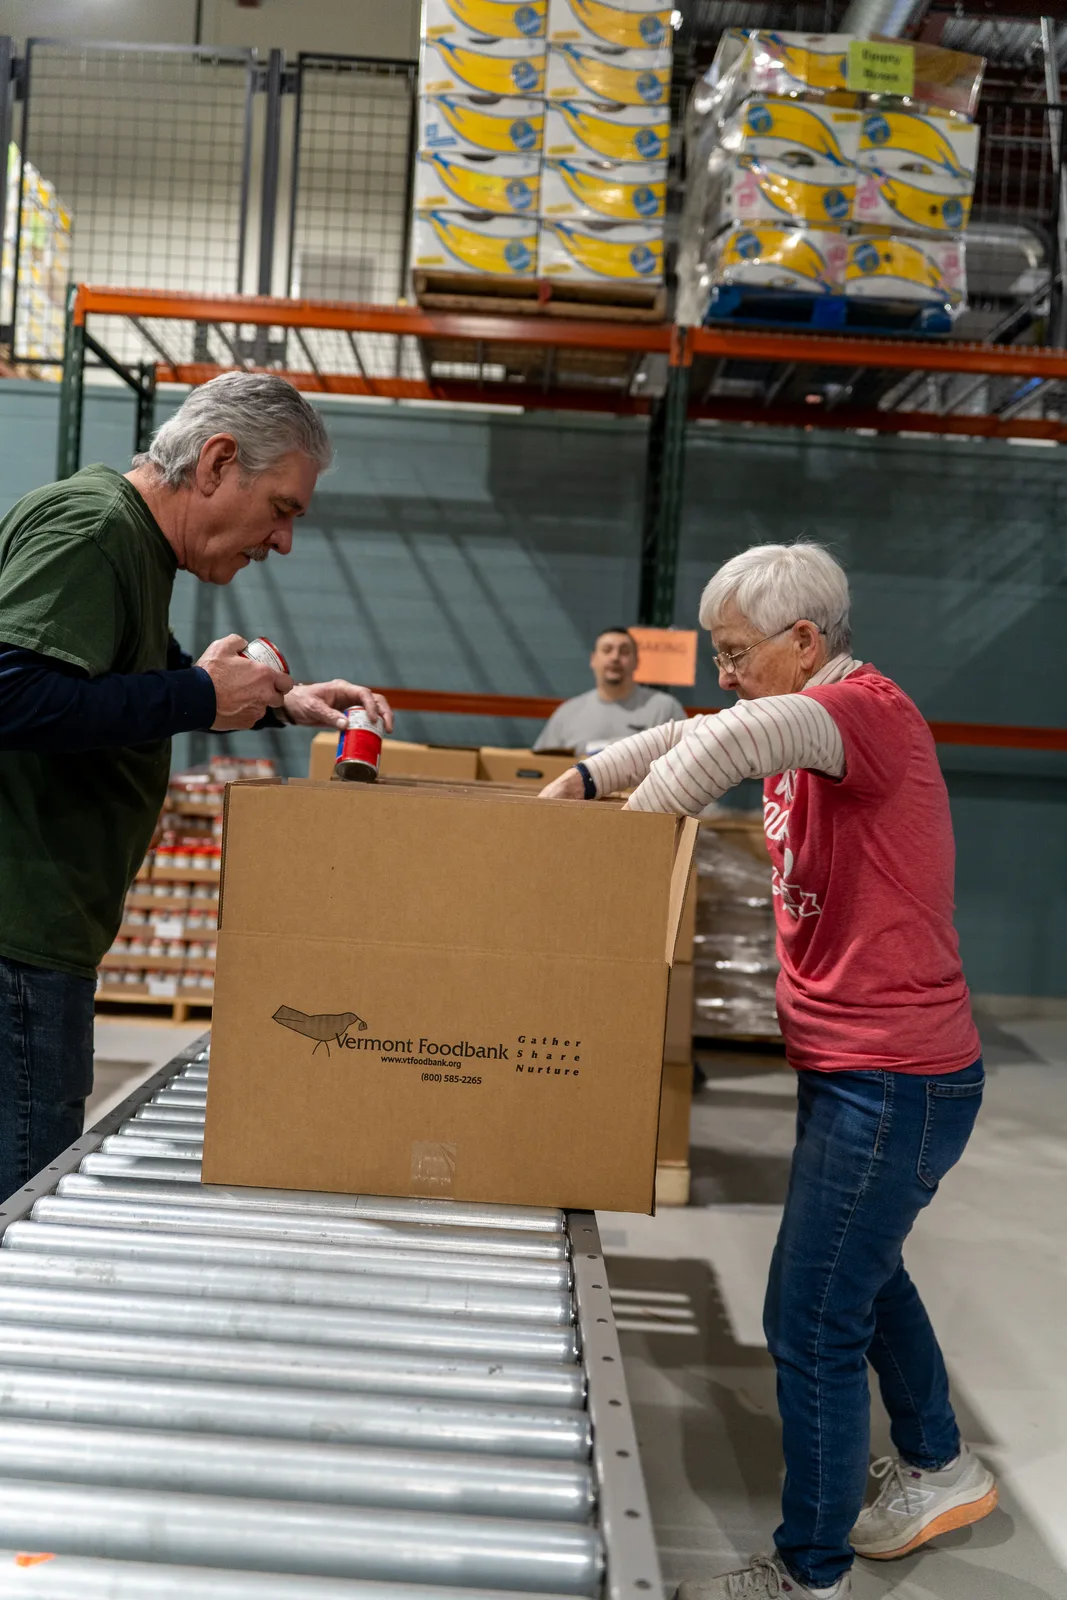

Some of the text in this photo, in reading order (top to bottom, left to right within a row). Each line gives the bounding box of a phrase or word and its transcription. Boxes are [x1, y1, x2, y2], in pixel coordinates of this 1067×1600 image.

[335, 1032, 509, 1060] Vermont Foodbank
[518, 1035, 581, 1047] Gather
[516, 1049, 580, 1061] Share
[380, 1055, 462, 1069] www.vtfoodbank.org
[515, 1064, 580, 1076] Nurture
[421, 1072, 482, 1085] (800) 585-2265
